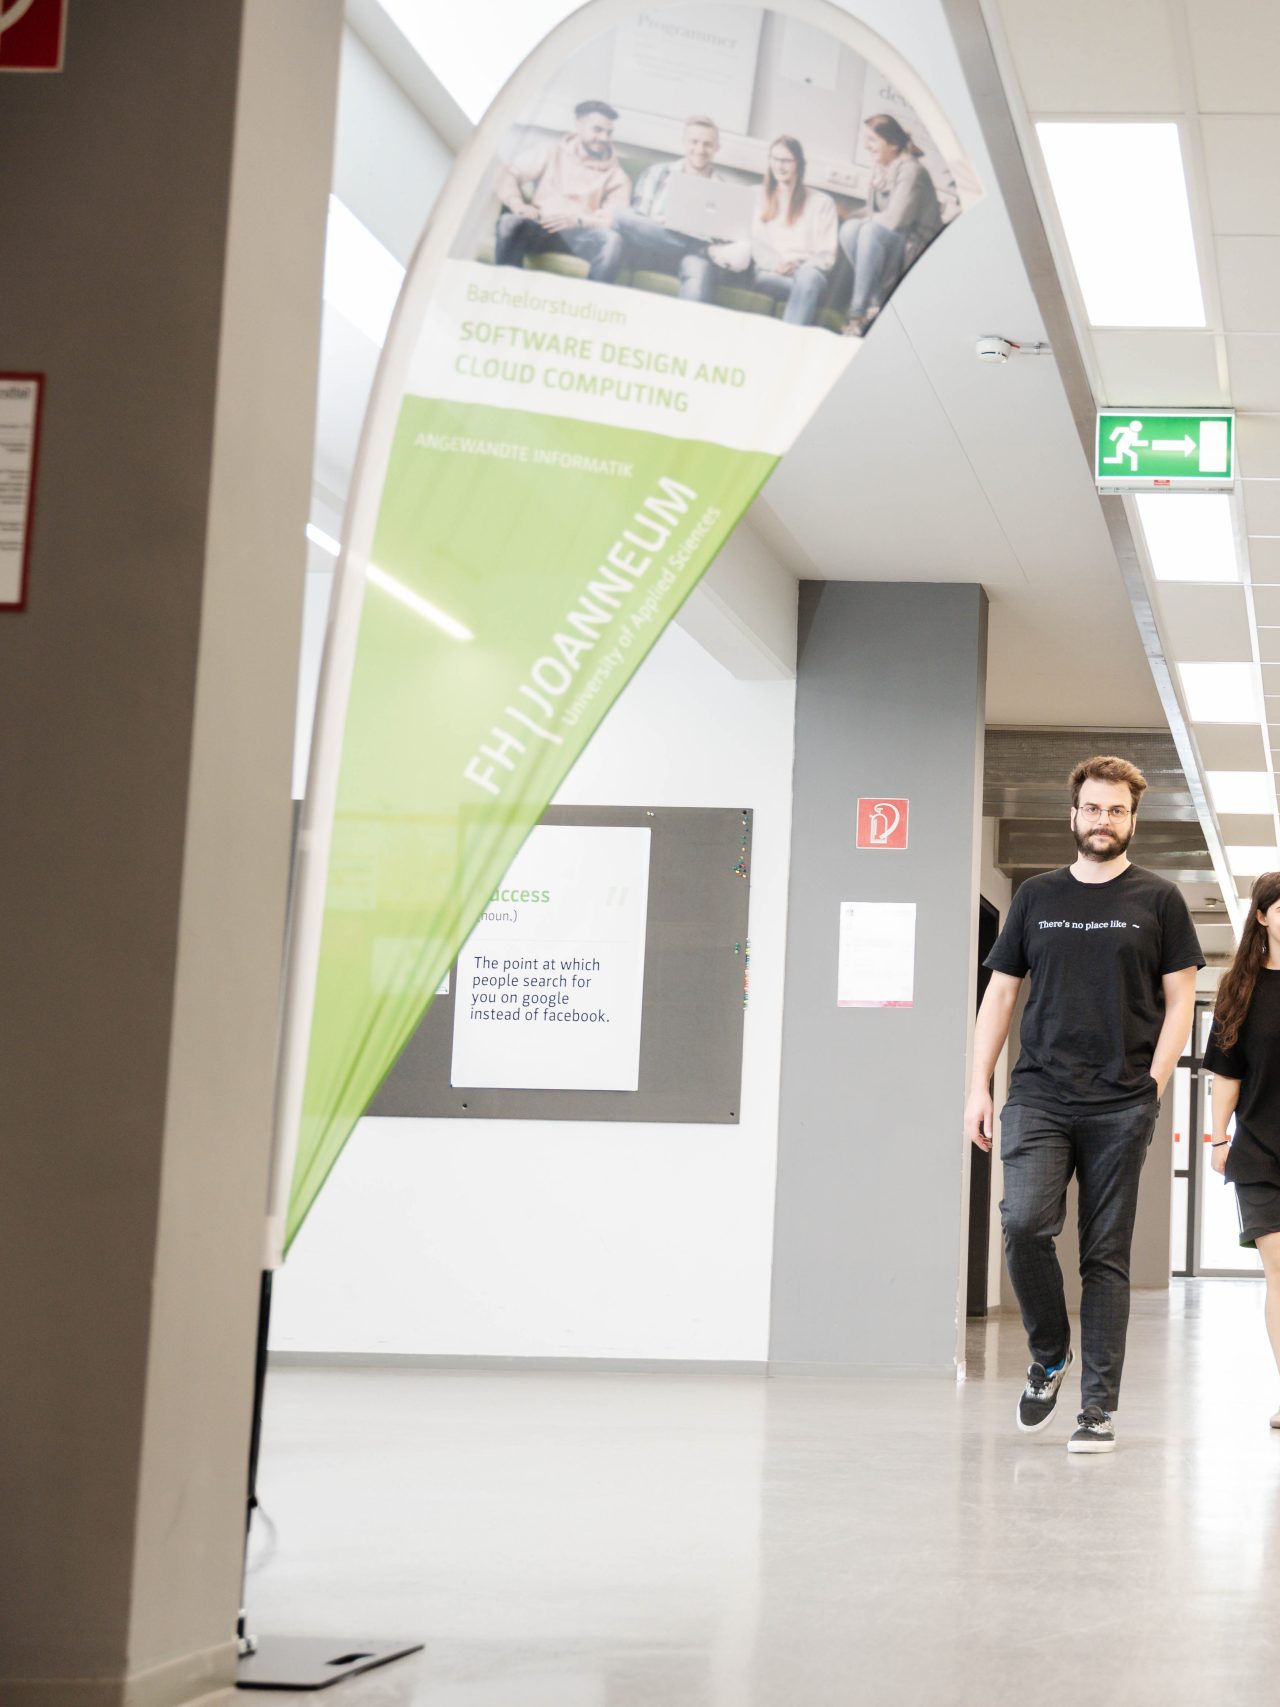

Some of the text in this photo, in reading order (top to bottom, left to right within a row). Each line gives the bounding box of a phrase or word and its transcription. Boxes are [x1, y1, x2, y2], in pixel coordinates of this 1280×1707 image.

[637, 12, 739, 50] Programmer
[466, 283, 628, 327] Bachelorstudium
[459, 321, 747, 388] SOFTWARE DESIGN AND
[454, 354, 689, 412] CLOUD COMPUTING
[413, 432, 634, 478] ANGEWANDTE INFORMATIK
[562, 505, 721, 727] University of Applied Sciences
[463, 727, 526, 796] FH
[519, 475, 698, 719] JOANNEUM
[490, 885, 550, 903] uccess
[479, 908, 518, 924] noun.)
[1038, 920, 1070, 929] There's
[1072, 921, 1084, 929] no
[1085, 921, 1109, 931] place
[1110, 920, 1127, 928] like
[474, 956, 600, 972] The point at which
[472, 974, 592, 989] people search for
[471, 992, 570, 1008] you on google
[470, 1007, 610, 1023] instead of facebook.
